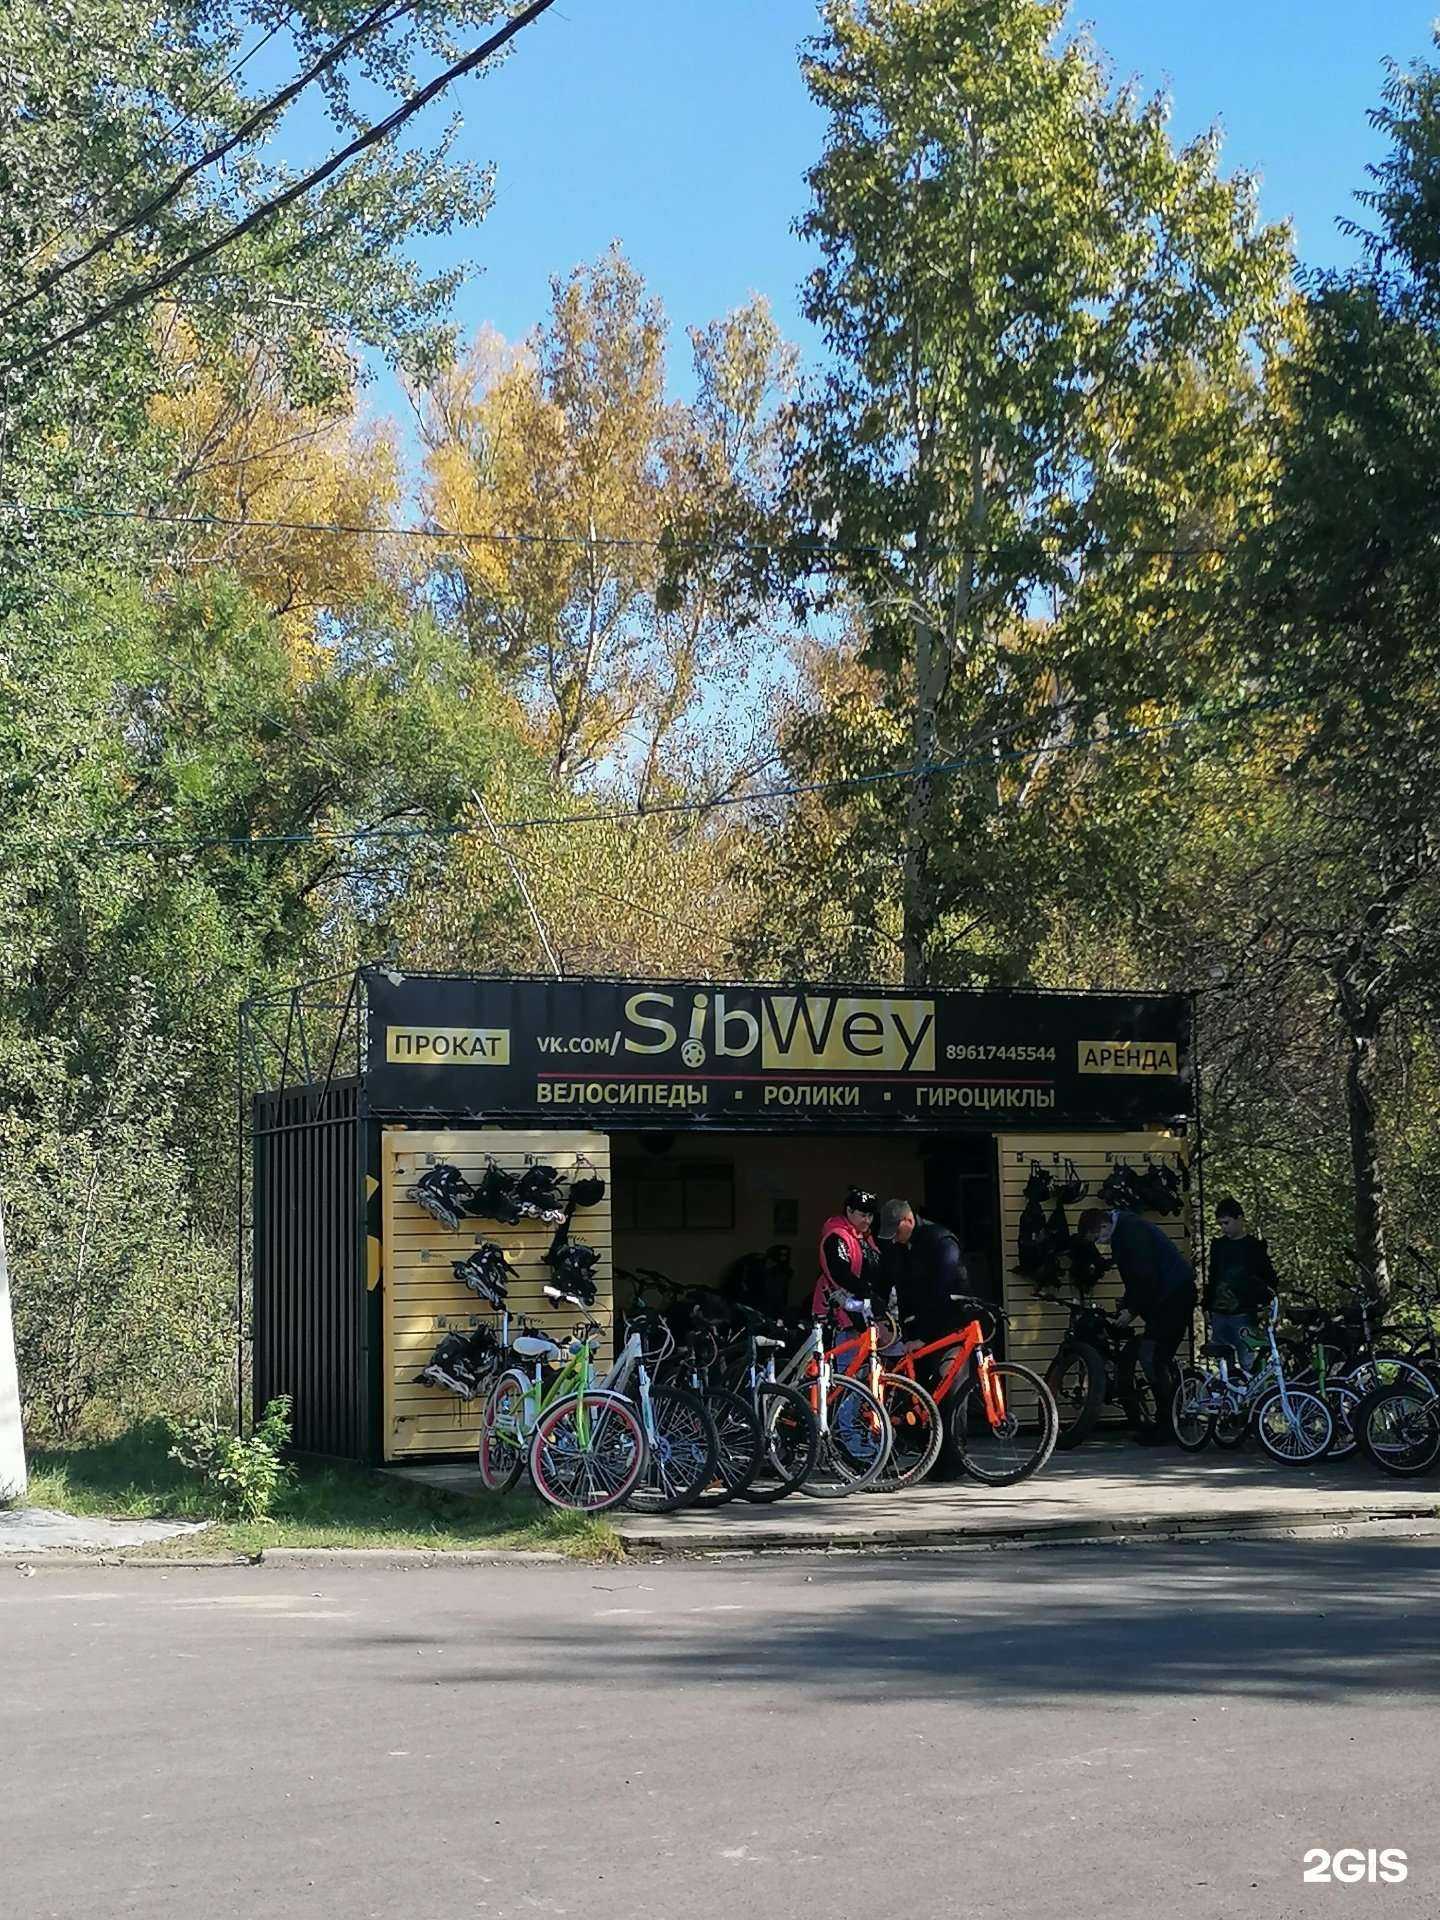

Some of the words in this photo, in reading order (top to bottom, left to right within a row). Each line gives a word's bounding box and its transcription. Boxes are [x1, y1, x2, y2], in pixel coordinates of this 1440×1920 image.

[394, 1035, 502, 1057] ПРОКАТ
[536, 1031, 622, 1057] VK.COM/
[945, 1045, 1056, 1062] 89617445544
[1083, 1048, 1172, 1070] АРЕНДА
[536, 1083, 708, 1108] ВЕЛОСИПЕДЫ
[763, 1086, 860, 1106] РОЛИКИ
[915, 1087, 1055, 1110] ГИРОЦИКЛЫ
